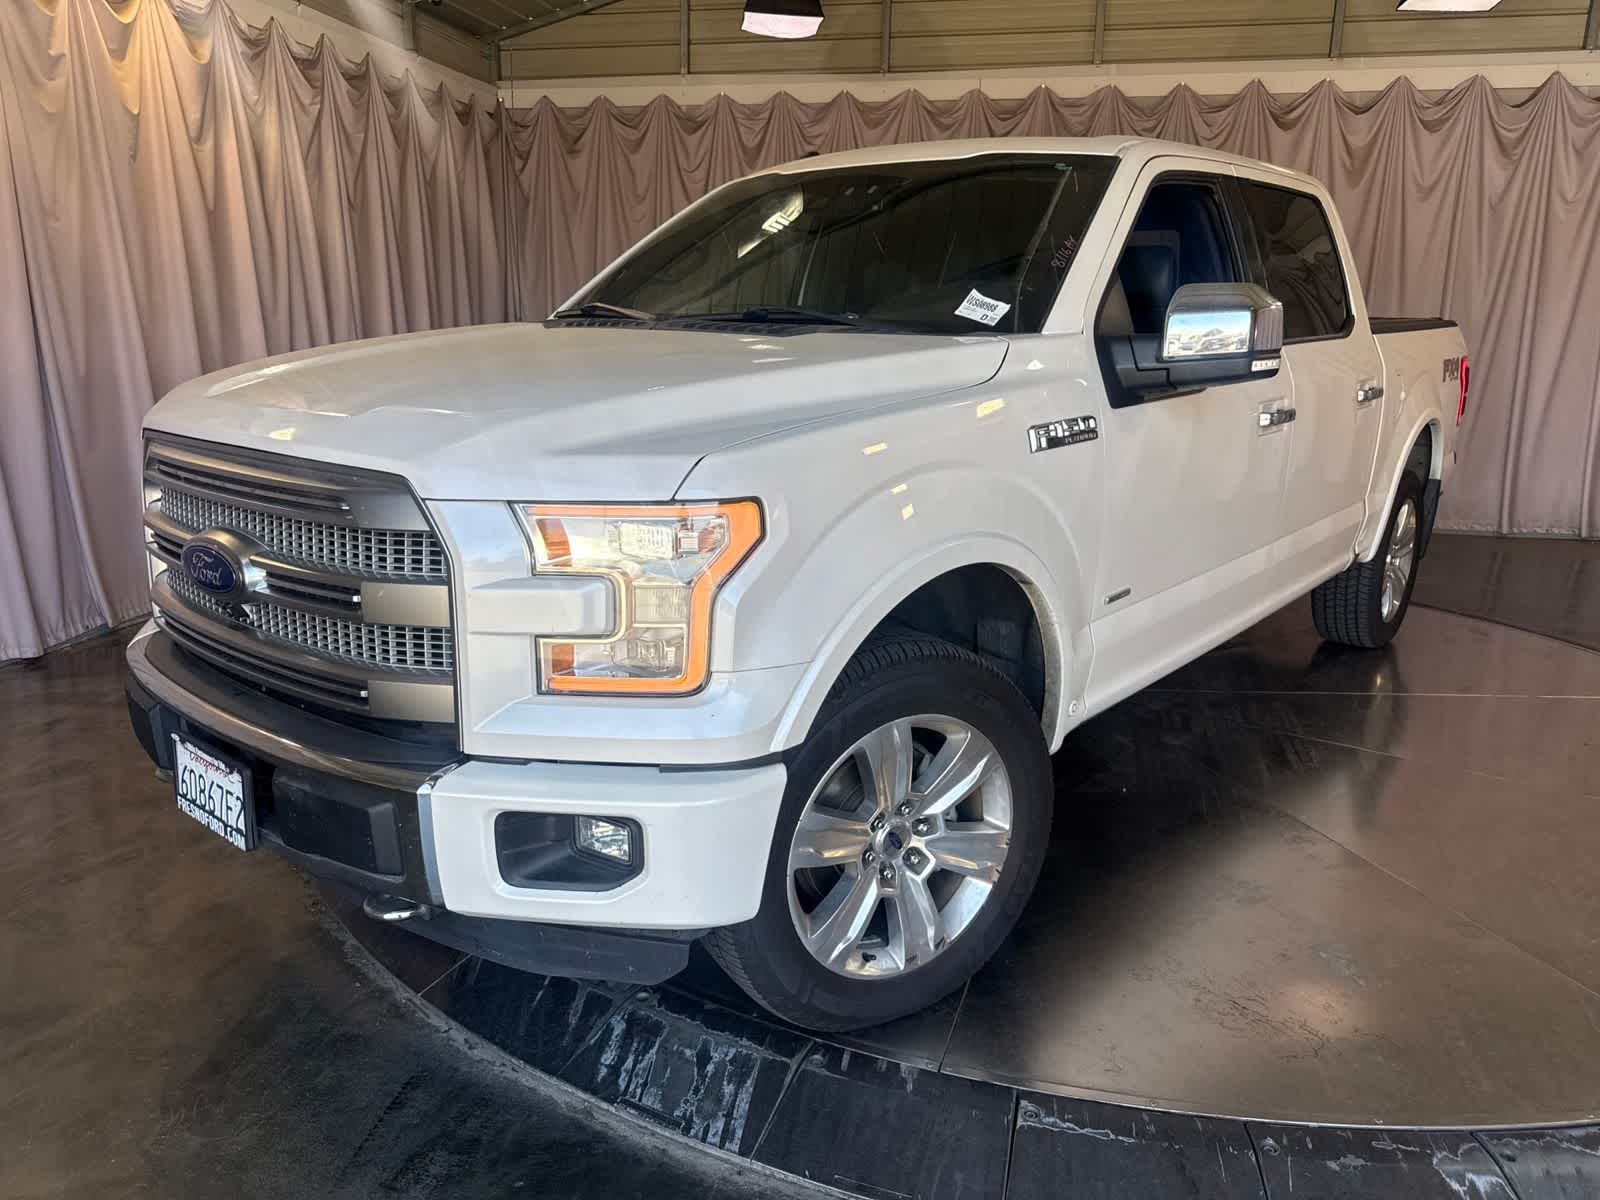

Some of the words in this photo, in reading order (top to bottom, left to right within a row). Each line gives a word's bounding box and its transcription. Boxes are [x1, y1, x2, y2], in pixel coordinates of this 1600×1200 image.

[190, 552, 223, 585] Ford
[177, 795, 246, 851] FRESNOFORD.COM
[181, 764, 245, 835] 60867F2
